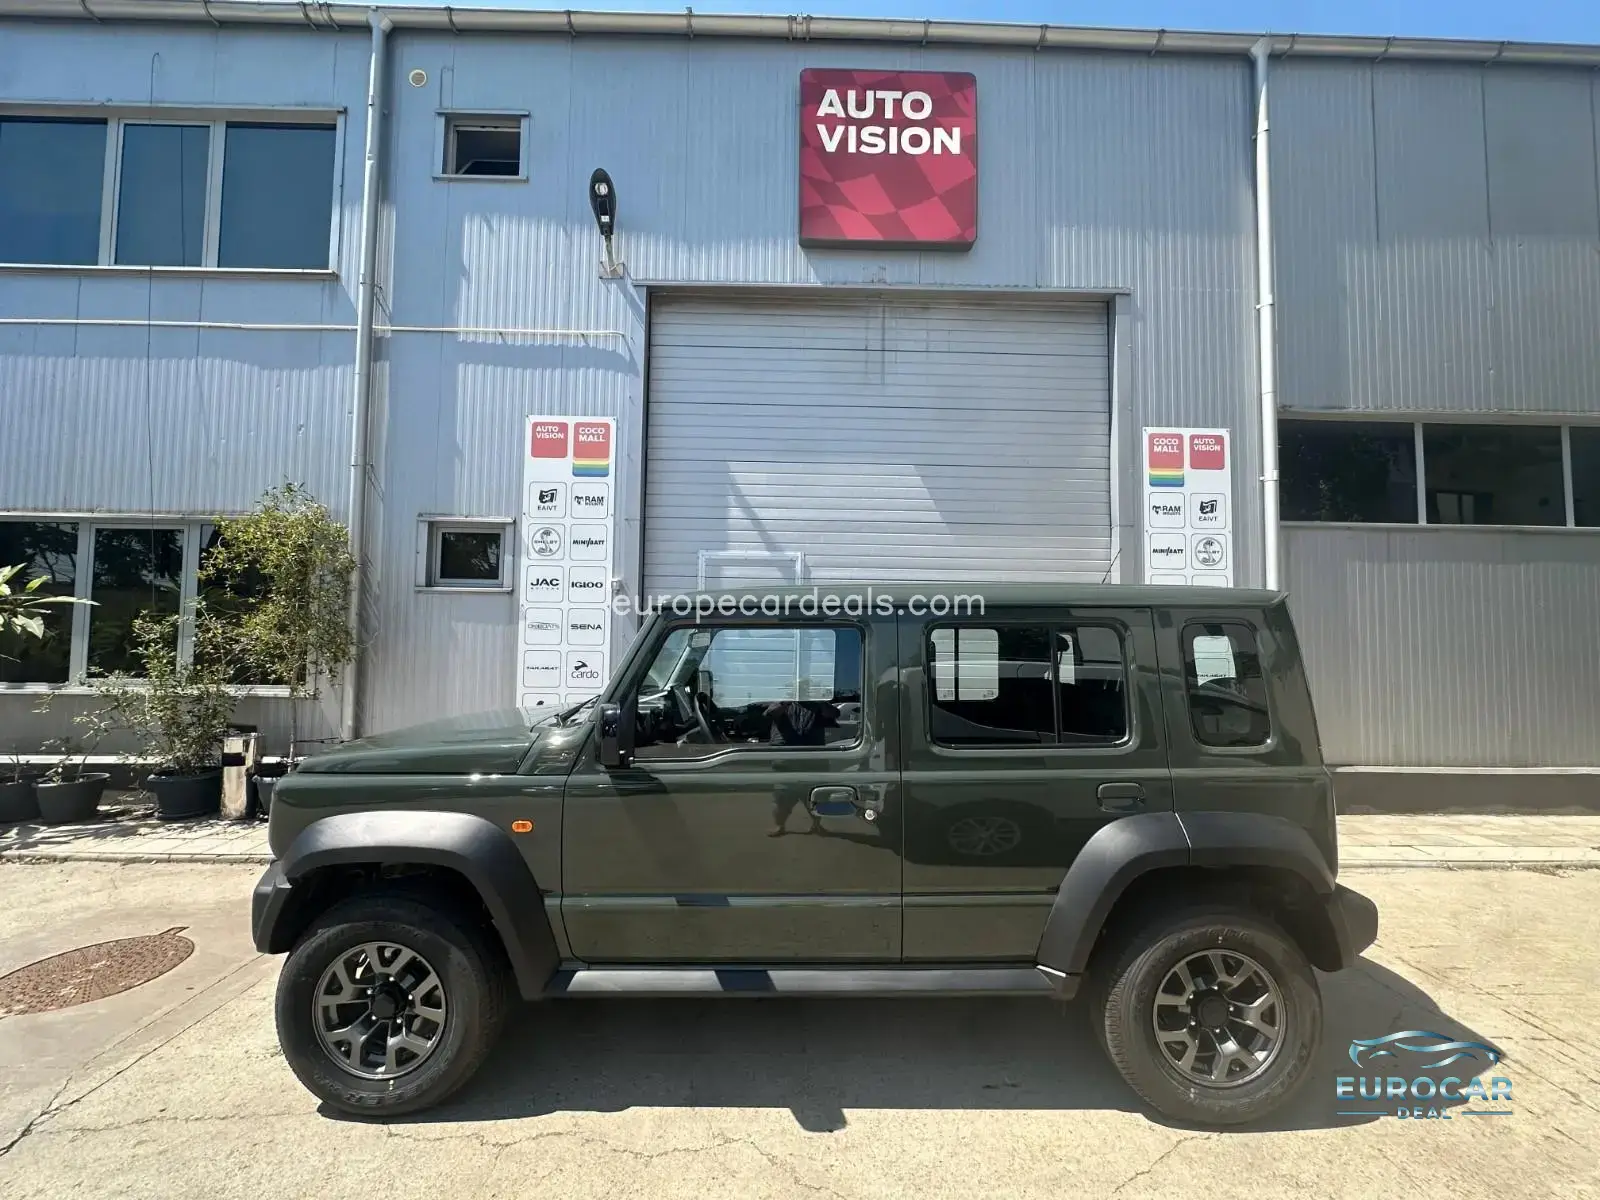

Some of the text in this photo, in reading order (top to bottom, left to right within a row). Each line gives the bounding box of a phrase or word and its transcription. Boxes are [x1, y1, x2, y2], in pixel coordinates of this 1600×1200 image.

[816, 89, 933, 120] AUTO
[816, 124, 961, 155] VISION
[578, 434, 606, 442] MALL
[1153, 437, 1179, 445] COCO
[1153, 445, 1180, 453] MALL
[530, 578, 560, 587] JAC
[571, 669, 599, 679] cardo
